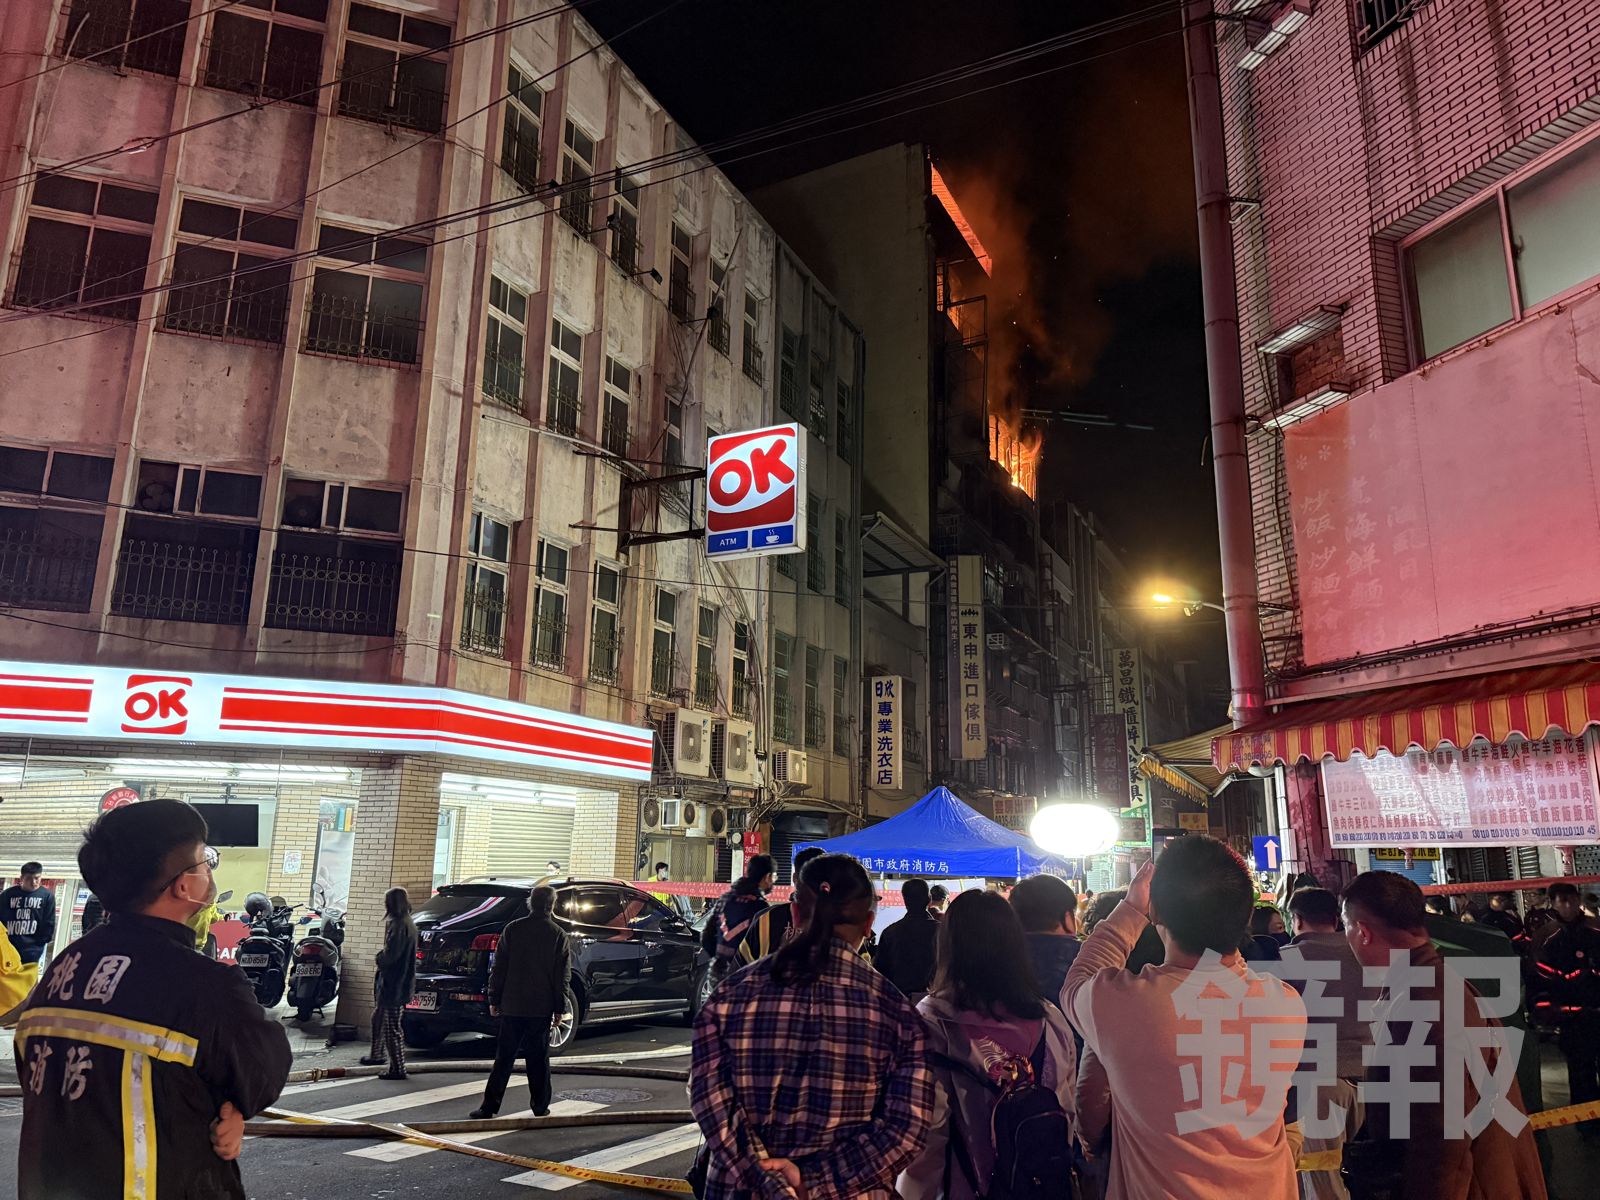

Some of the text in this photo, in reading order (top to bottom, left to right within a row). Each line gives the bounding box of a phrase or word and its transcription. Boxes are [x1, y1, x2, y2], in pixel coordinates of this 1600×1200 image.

[709, 438, 796, 507] OK
[719, 537, 737, 547] ATM
[124, 688, 189, 720] OK
[877, 701, 894, 786] 專業洗衣店
[857, 857, 949, 873] 園市政府消防局
[10, 896, 42, 909] WE LOVE
[16, 908, 31, 920] OUR
[7, 919, 38, 935] WORLD
[47, 951, 131, 1005] 桃園
[28, 1040, 94, 1101] 消防
